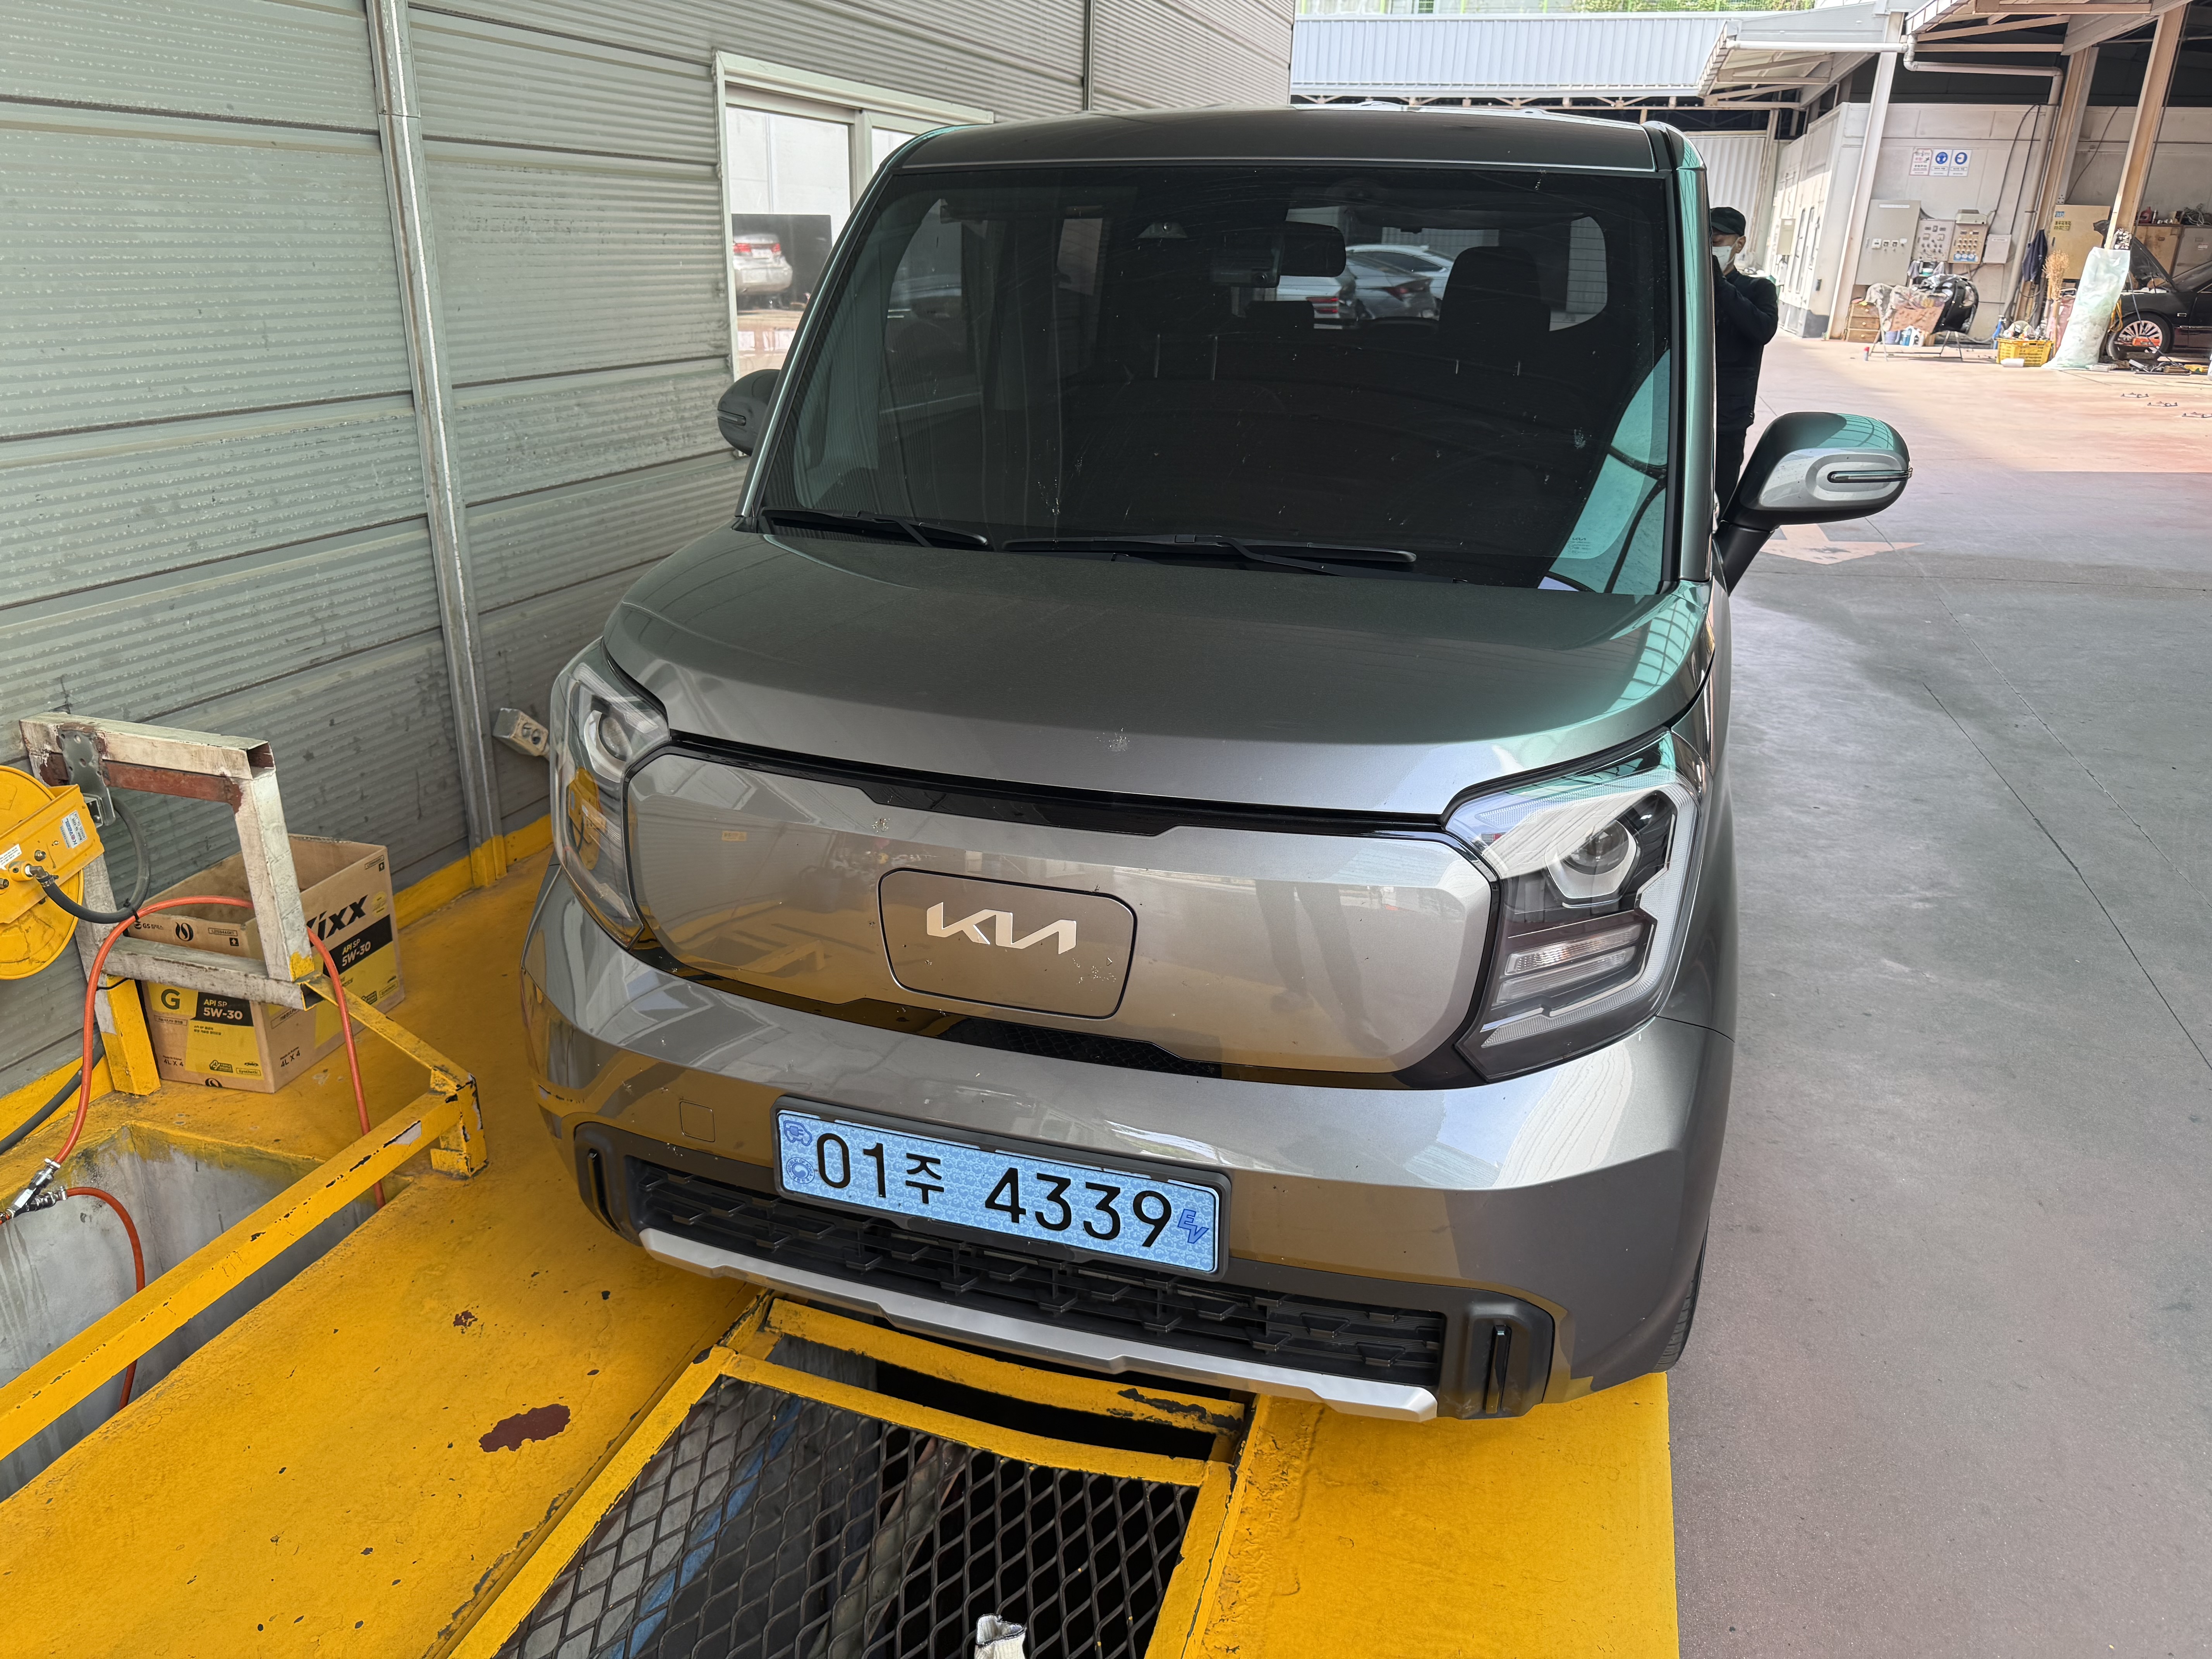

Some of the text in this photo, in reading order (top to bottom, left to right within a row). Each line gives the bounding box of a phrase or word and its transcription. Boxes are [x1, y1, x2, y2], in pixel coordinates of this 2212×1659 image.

[927, 902, 1077, 954] KIA
[342, 939, 361, 955] API SP
[342, 941, 371, 967] 5W-30
[161, 989, 180, 1010] G
[203, 1007, 243, 1020] 5W-30
[817, 1133, 1172, 1247] 01주 4339
[1177, 1209, 1209, 1244] EV
